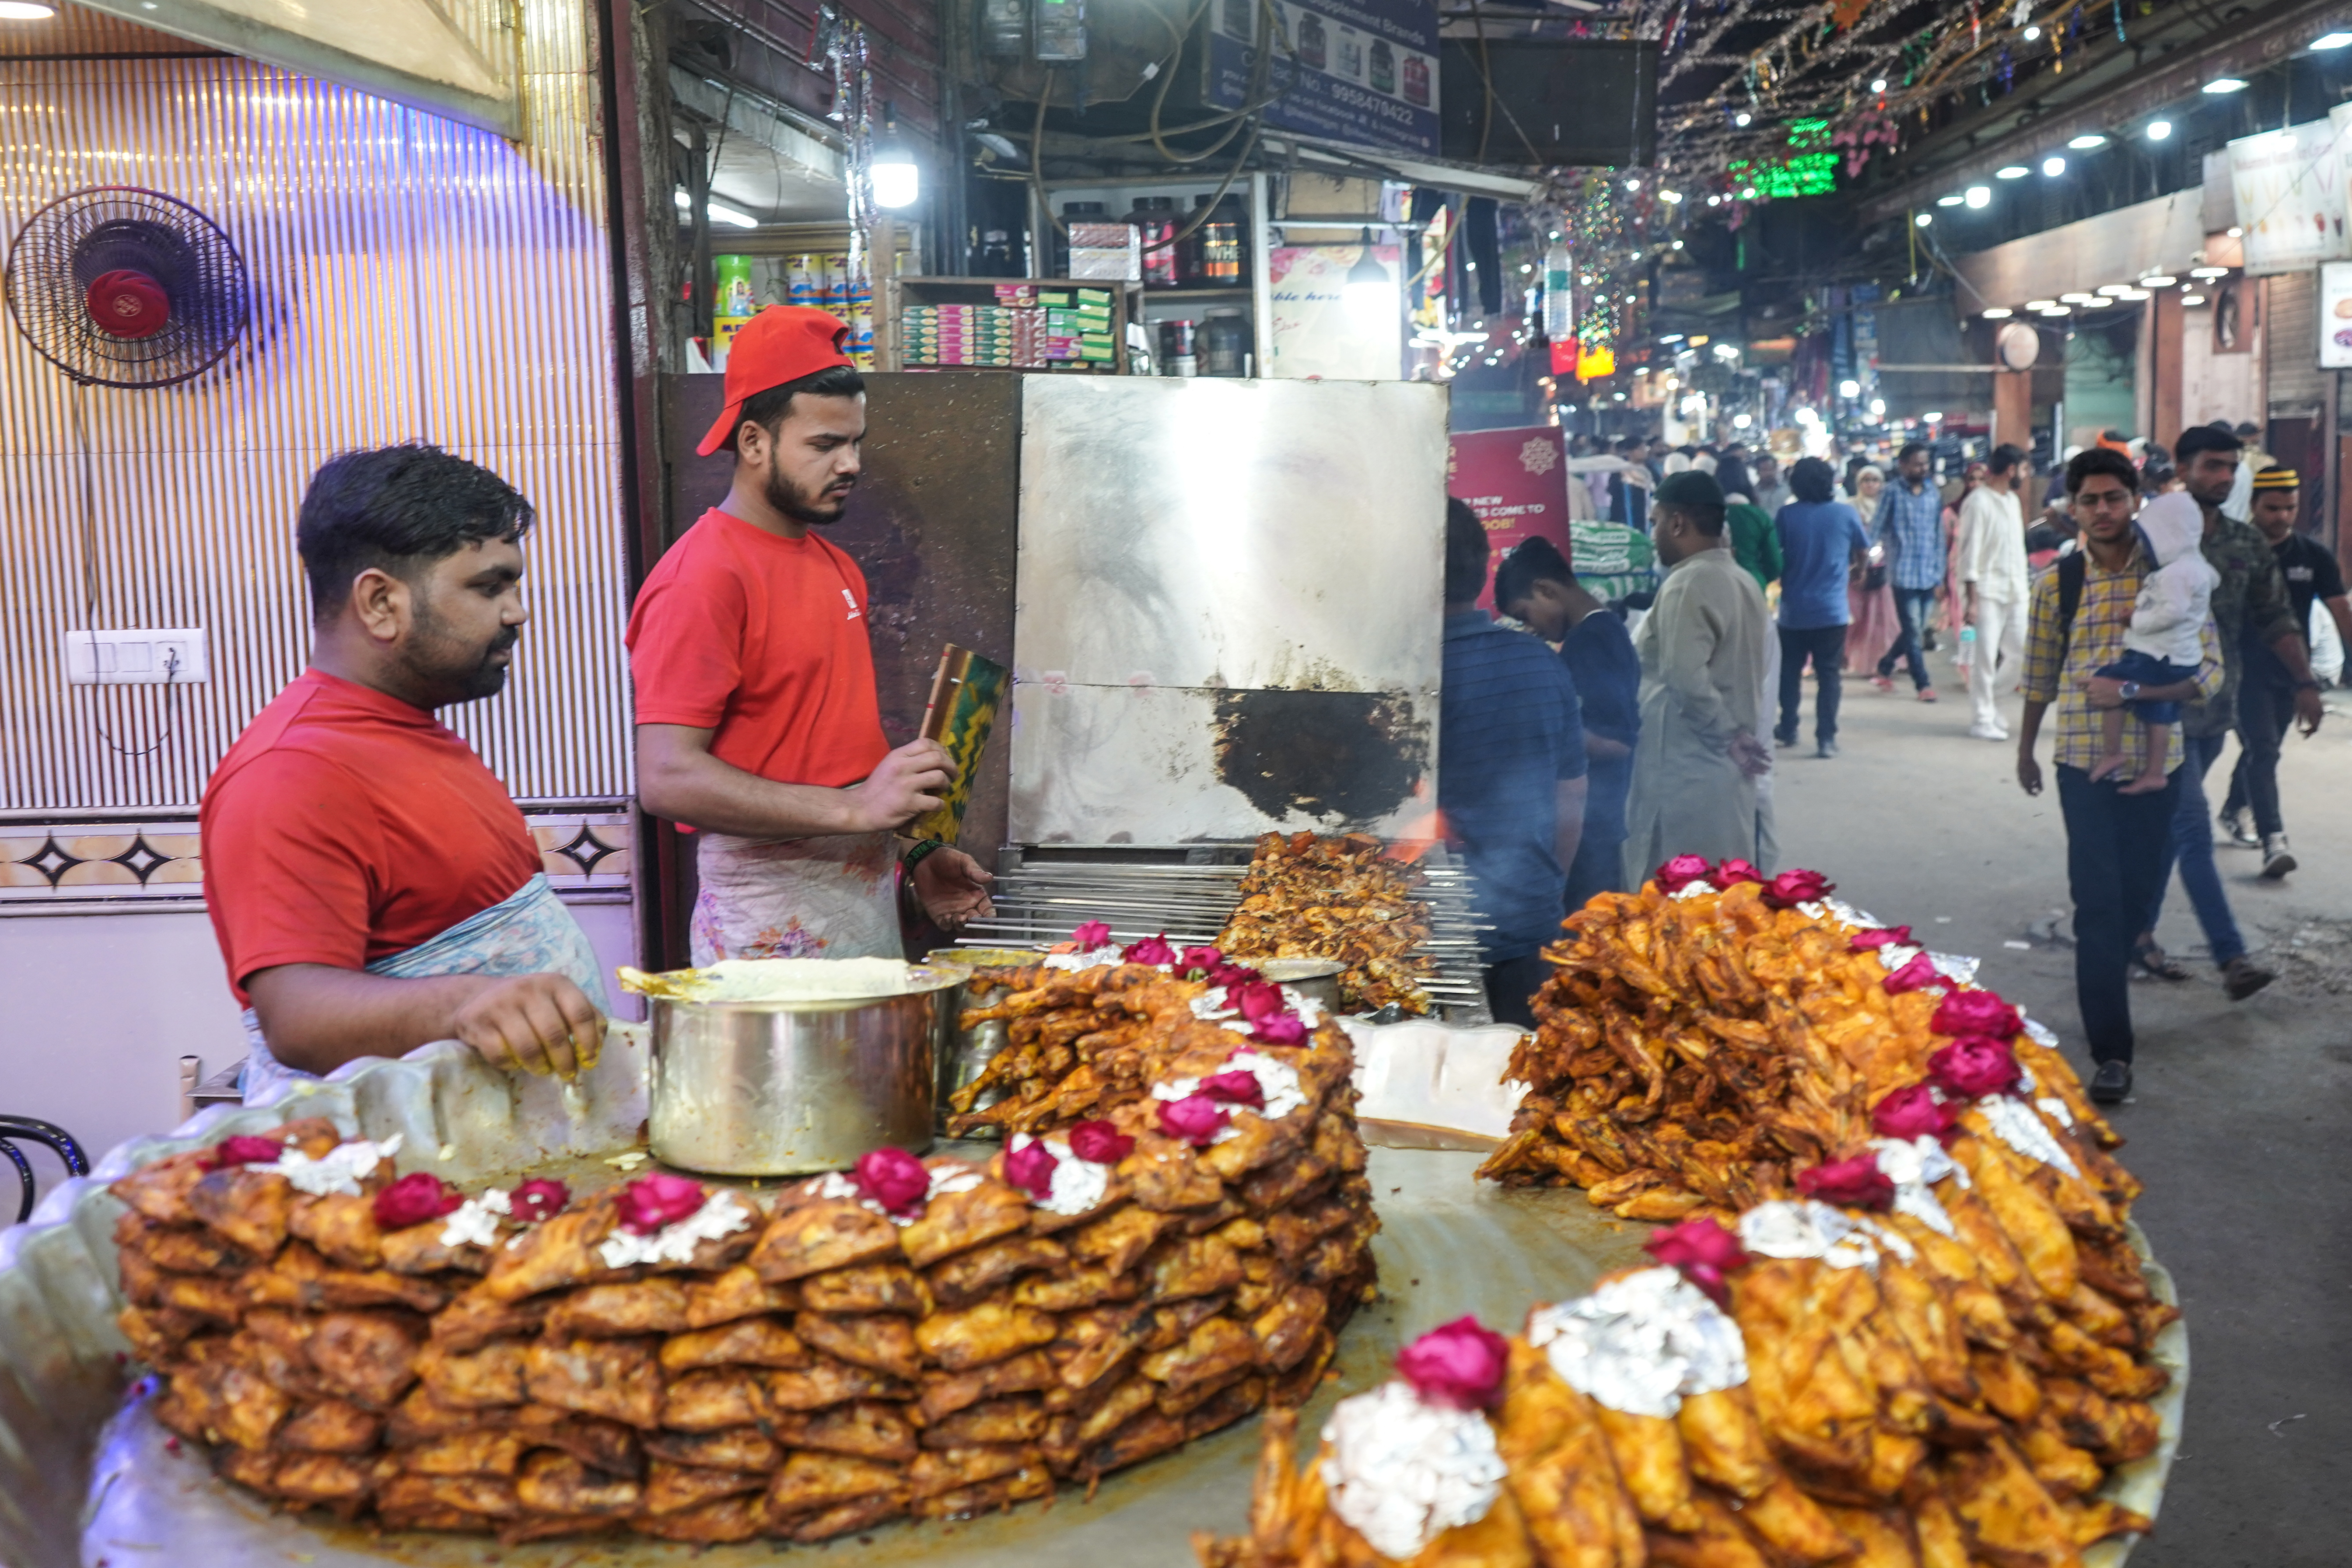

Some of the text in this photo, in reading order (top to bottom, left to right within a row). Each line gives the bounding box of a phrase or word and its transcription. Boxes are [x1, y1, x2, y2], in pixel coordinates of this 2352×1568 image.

[1473, 496, 1503, 507] NEW
[1490, 505, 1526, 517] COME
[1526, 503, 1545, 514] TO
